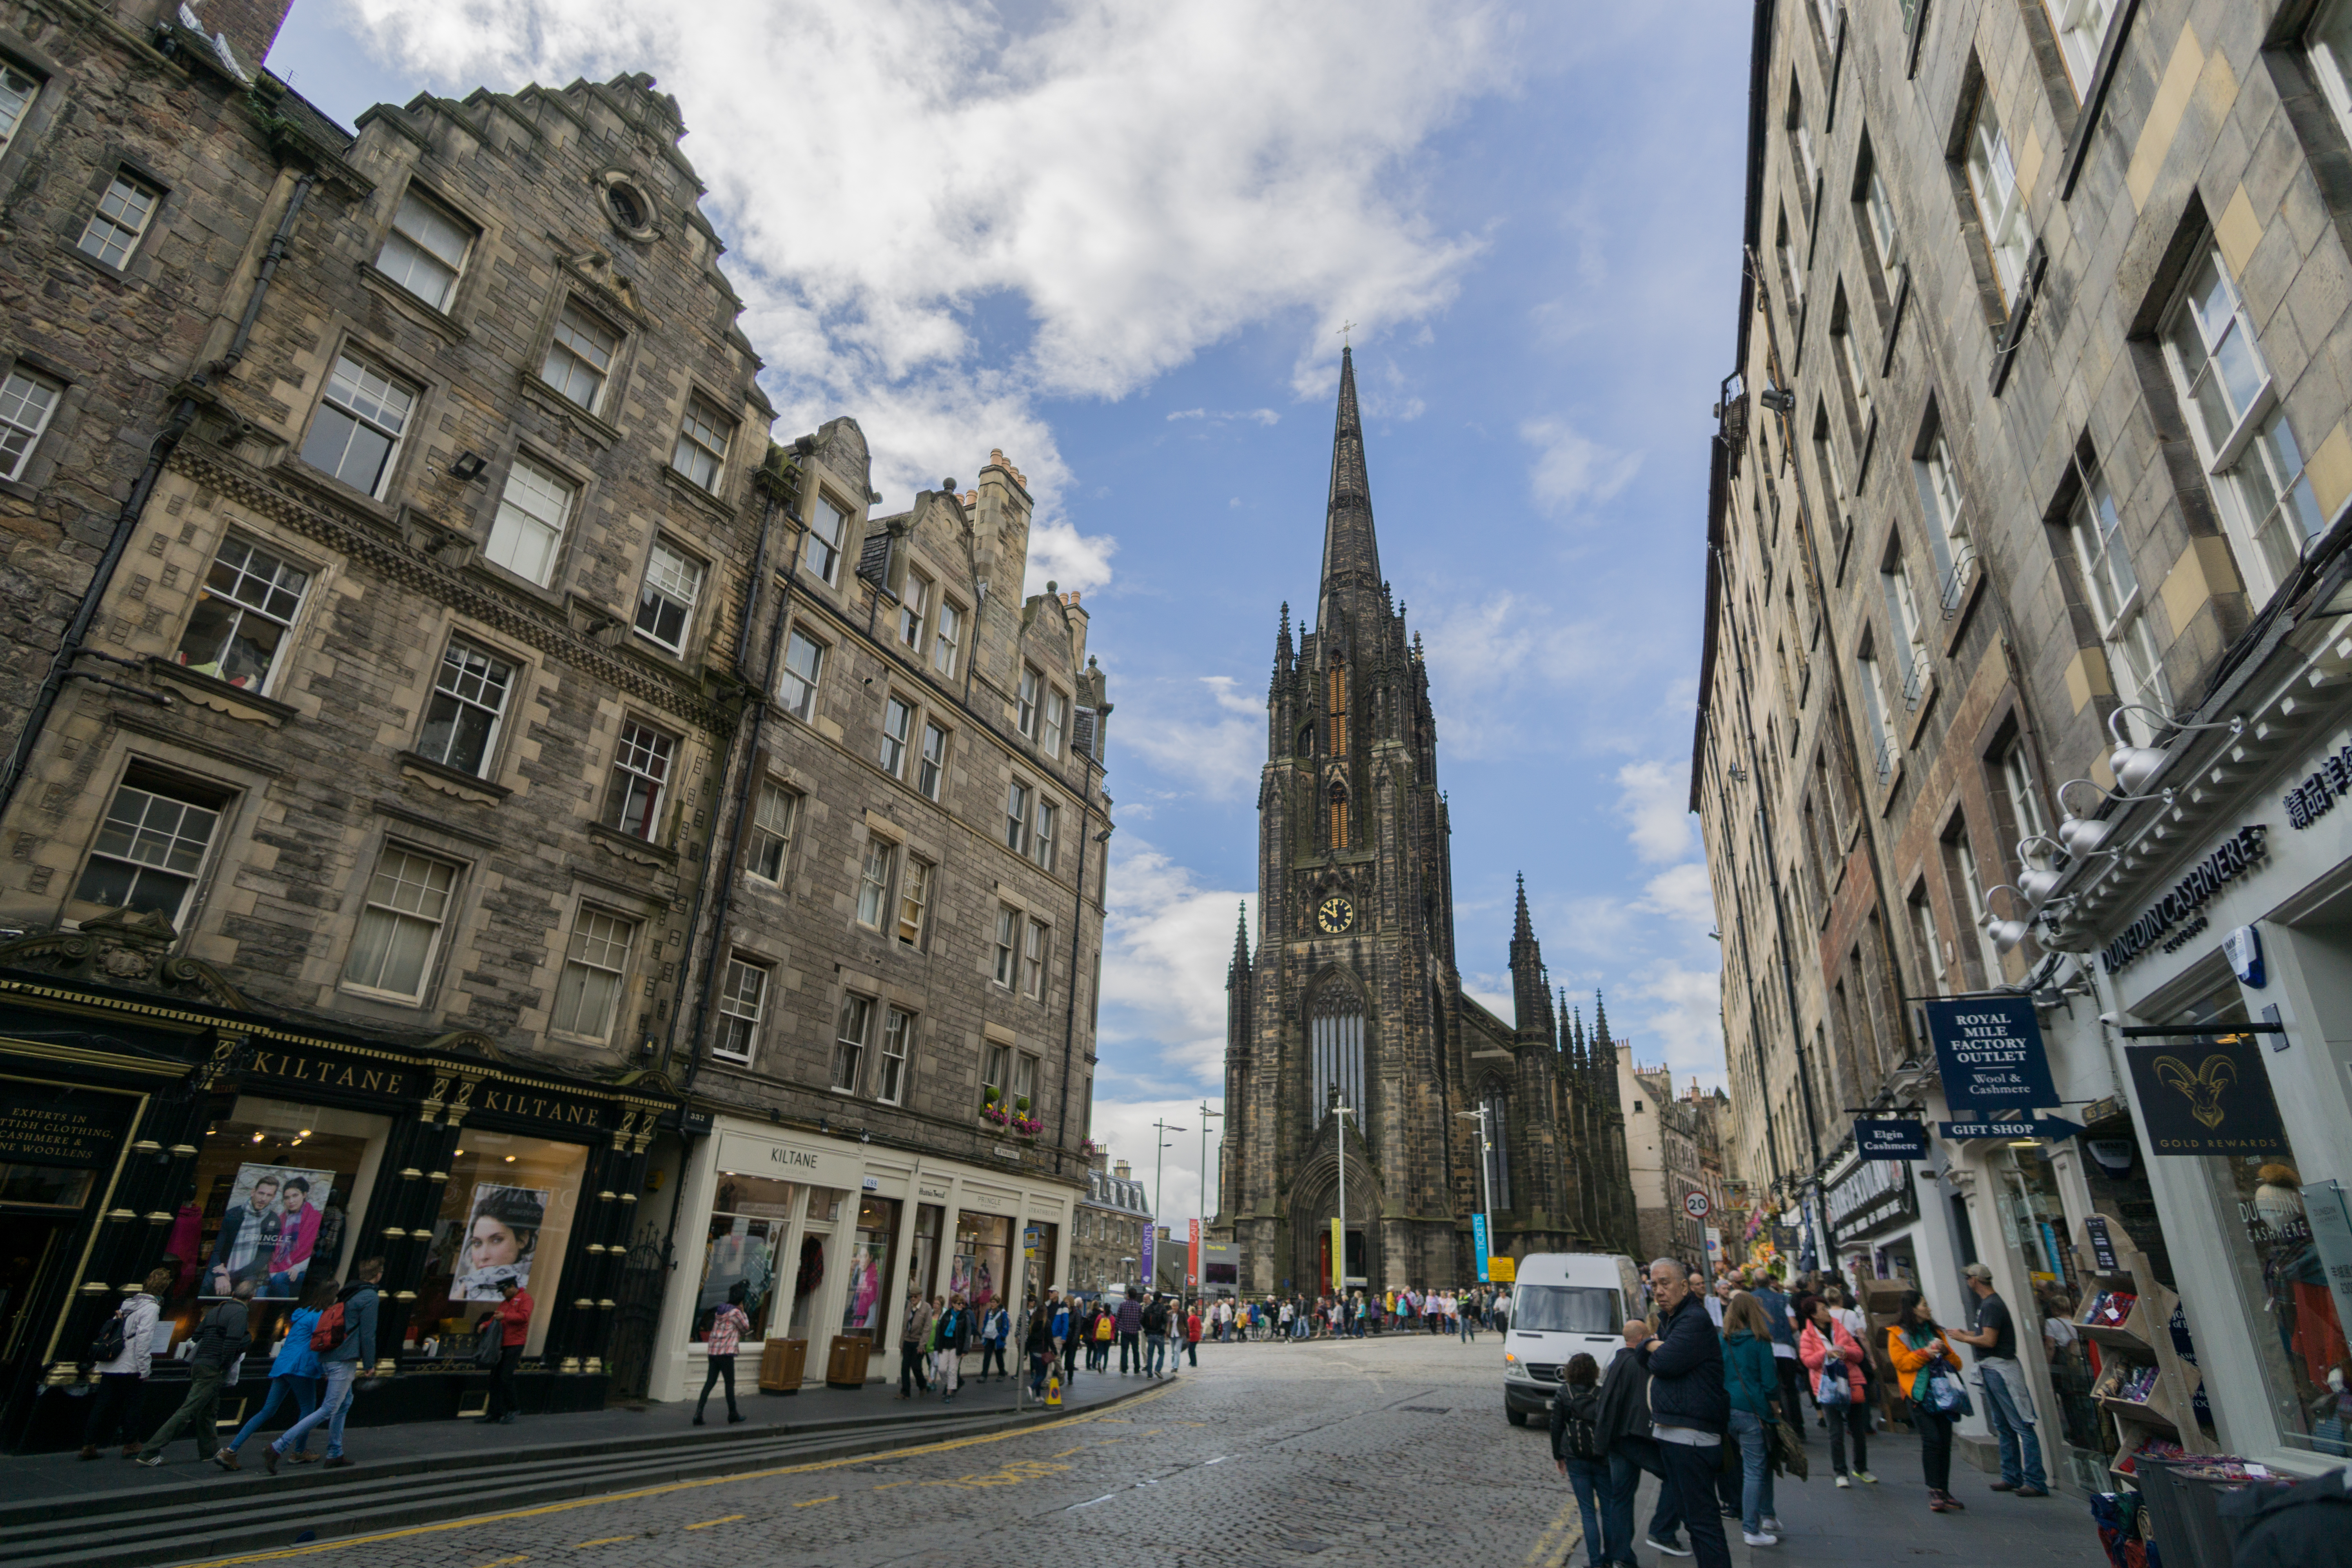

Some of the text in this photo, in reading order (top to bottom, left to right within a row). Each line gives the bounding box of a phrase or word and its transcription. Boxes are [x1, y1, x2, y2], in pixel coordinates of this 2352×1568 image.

[2101, 824, 2263, 975] DUNEDIN CASHMERE
[1955, 1013, 2011, 1026] ROYAL
[1964, 1026, 2008, 1037] MILE
[1950, 1038, 2027, 1051] FACTORY
[1957, 1051, 2026, 1063] OUTLET
[250, 1051, 402, 1094] KILTANE
[1972, 1073, 2022, 1083] Wool &
[1969, 1083, 2031, 1095] Cashmere
[484, 1091, 599, 1127] KILTANE
[12, 1108, 87, 1123] EXPERTS IN
[690, 1112, 705, 1122] 332
[44, 1123, 114, 1140] CLOTHING,
[1873, 1129, 1904, 1140] Elgin
[1951, 1124, 2034, 1135] GIFT SHOP
[0, 1130, 69, 1144] CASHMERE
[2160, 1139, 2277, 1147] GOLD REWARDS
[22, 1144, 93, 1159] WOOLLENS
[1863, 1141, 1918, 1150] Cashmere
[771, 1147, 818, 1169] KILTANE
[919, 1187, 933, 1197] Harris
[977, 1196, 1001, 1206] PRINGLE
[1688, 1198, 1706, 1210] 20
[1028, 1207, 1059, 1217] STRATHBERRY
[1474, 1216, 1485, 1251] TICKETS
[2246, 1221, 2307, 1242] CASHMERE
[244, 1233, 292, 1243] PRINGLE
[1143, 1225, 1152, 1255] EVENTS
